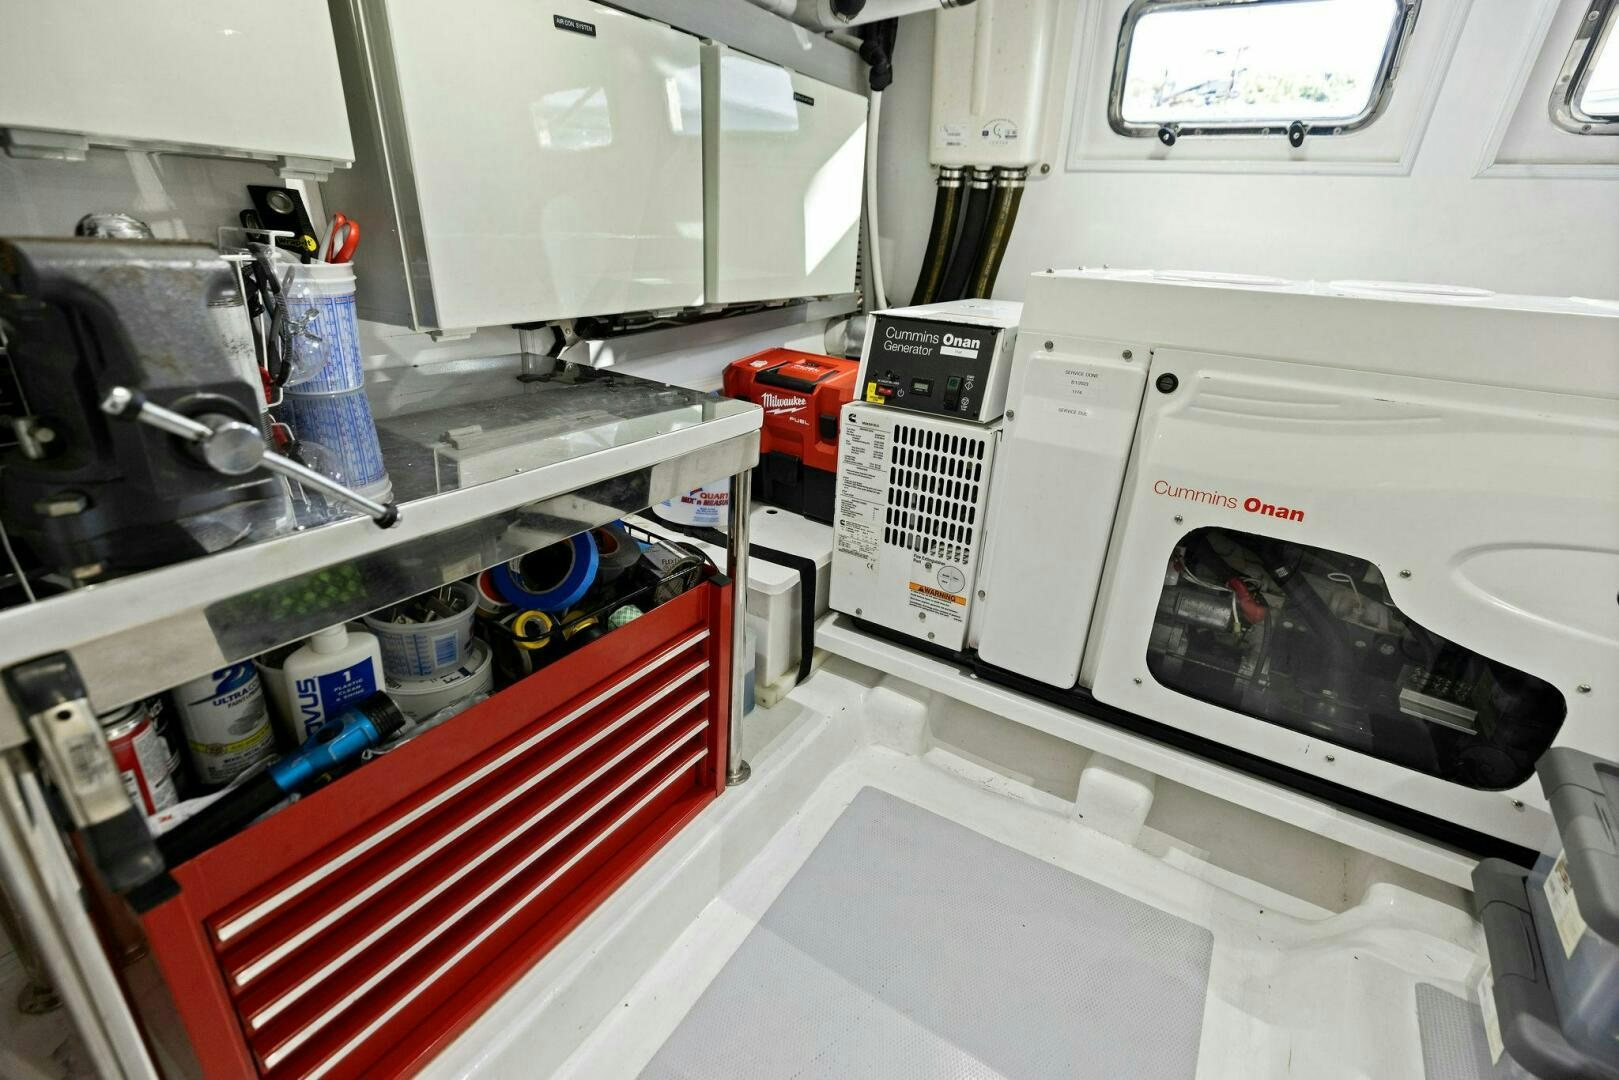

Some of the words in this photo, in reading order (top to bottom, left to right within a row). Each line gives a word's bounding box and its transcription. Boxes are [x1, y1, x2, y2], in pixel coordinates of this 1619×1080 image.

[885, 326, 940, 344] Cummins
[942, 333, 980, 349] Onan
[884, 340, 932, 356] Generator
[761, 392, 806, 408] Milwaukee
[789, 416, 809, 425] FUEL
[1153, 480, 1238, 509] Cummins
[1243, 497, 1305, 522] Onan
[924, 586, 956, 602] WARNING
[342, 670, 352, 682] 1
